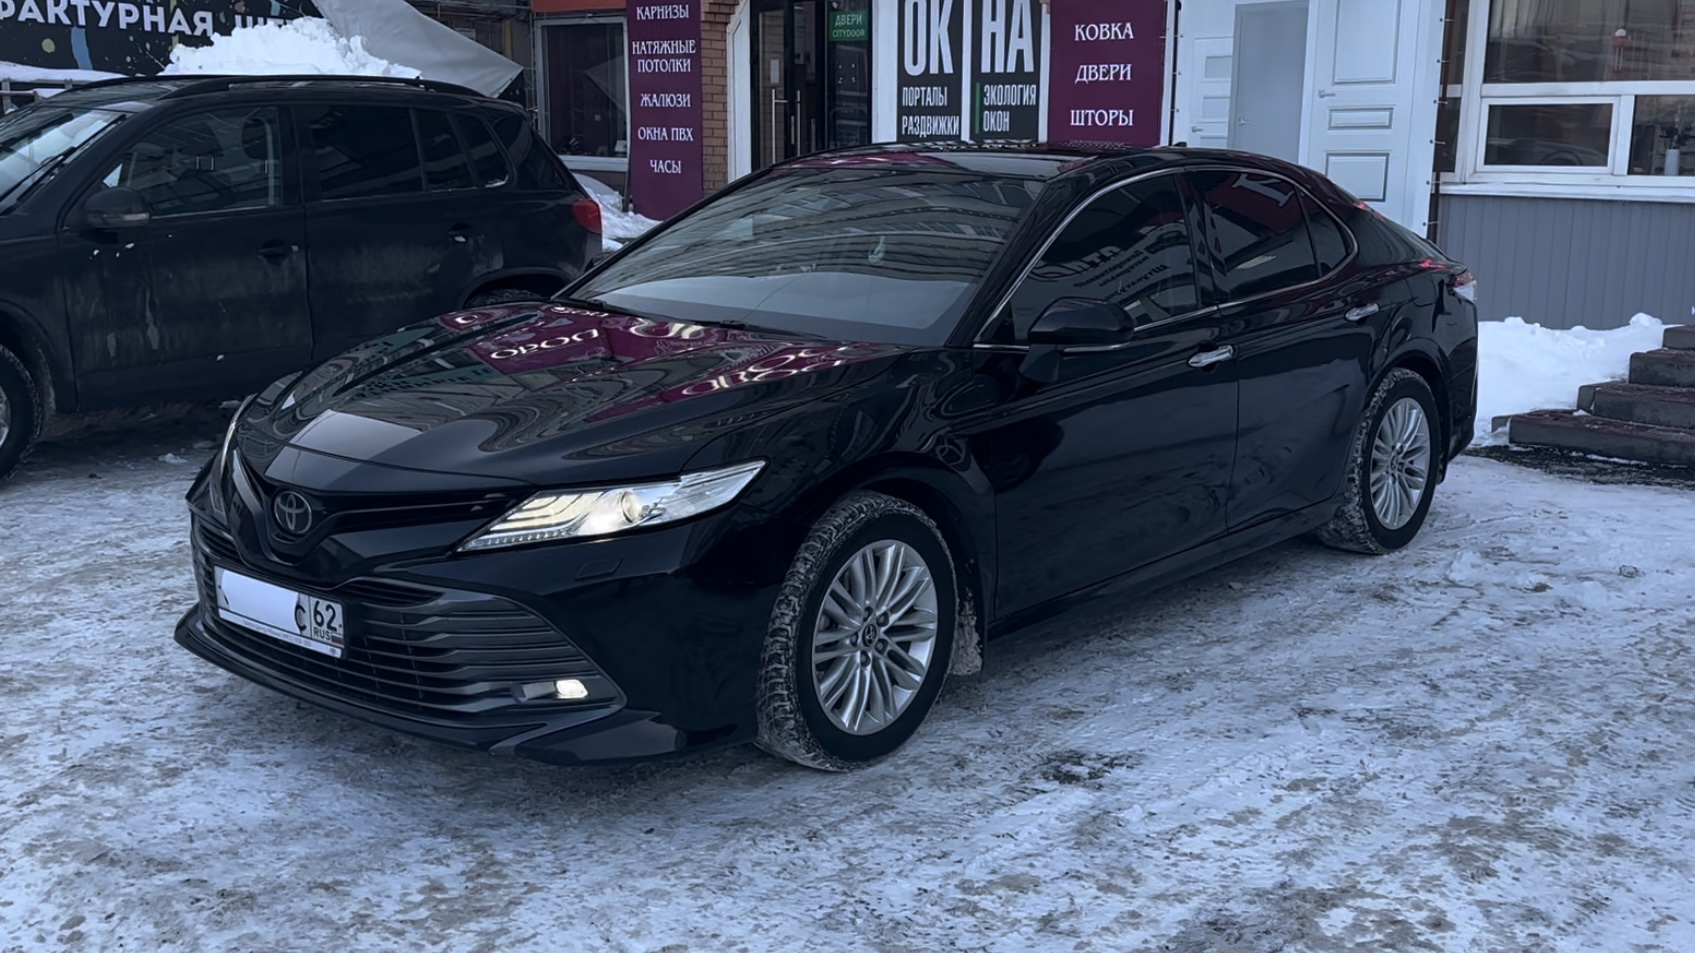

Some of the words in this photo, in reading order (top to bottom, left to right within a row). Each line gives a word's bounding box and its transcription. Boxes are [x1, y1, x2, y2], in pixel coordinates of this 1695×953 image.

[636, 4, 690, 20] КАРНИЗЫ
[835, 14, 863, 27] ДВЕРИ
[1074, 22, 1135, 42] КОВКА
[632, 39, 696, 55] НАТЯЖНЫЕ
[637, 58, 691, 73] ПОТОЛКИ
[1074, 63, 1133, 85] ДВЕРИ
[640, 93, 691, 108] ЖАЛЮЗИ
[902, 86, 948, 107] ПОРТАЛЫ
[983, 84, 1037, 106] ЭКОЛОГИЯ
[902, 115, 960, 138] РАЗДВИЖКИ
[983, 110, 1010, 132] ОКОН
[1070, 109, 1134, 127] ШТОРЫ
[637, 127, 669, 141] ОКНА
[671, 127, 694, 142] ПВХ
[650, 159, 682, 174] ЧАСЫ
[313, 600, 337, 632] 62
[313, 626, 331, 640] RUS
